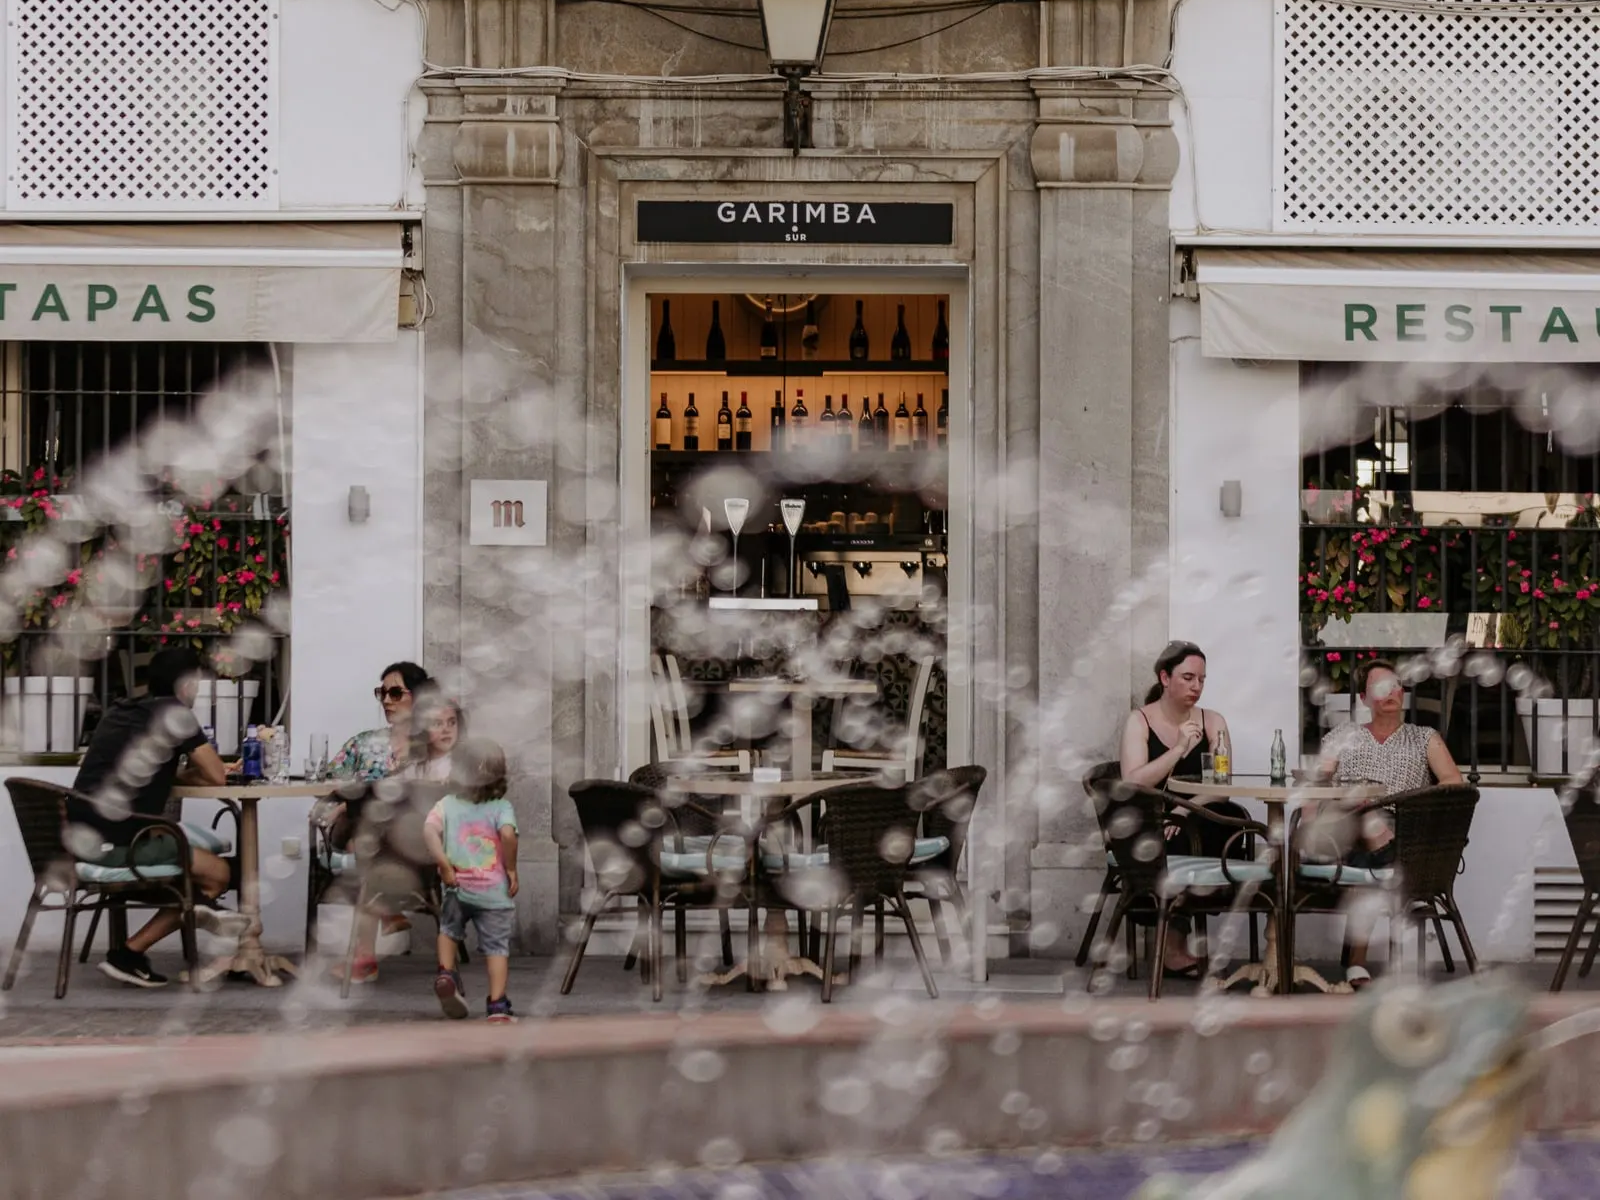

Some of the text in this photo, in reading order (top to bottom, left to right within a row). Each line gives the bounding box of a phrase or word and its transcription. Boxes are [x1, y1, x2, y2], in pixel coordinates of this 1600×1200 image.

[717, 203, 876, 223] GARIMBA
[1344, 303, 1600, 343] RESTA
[490, 499, 526, 528] m
